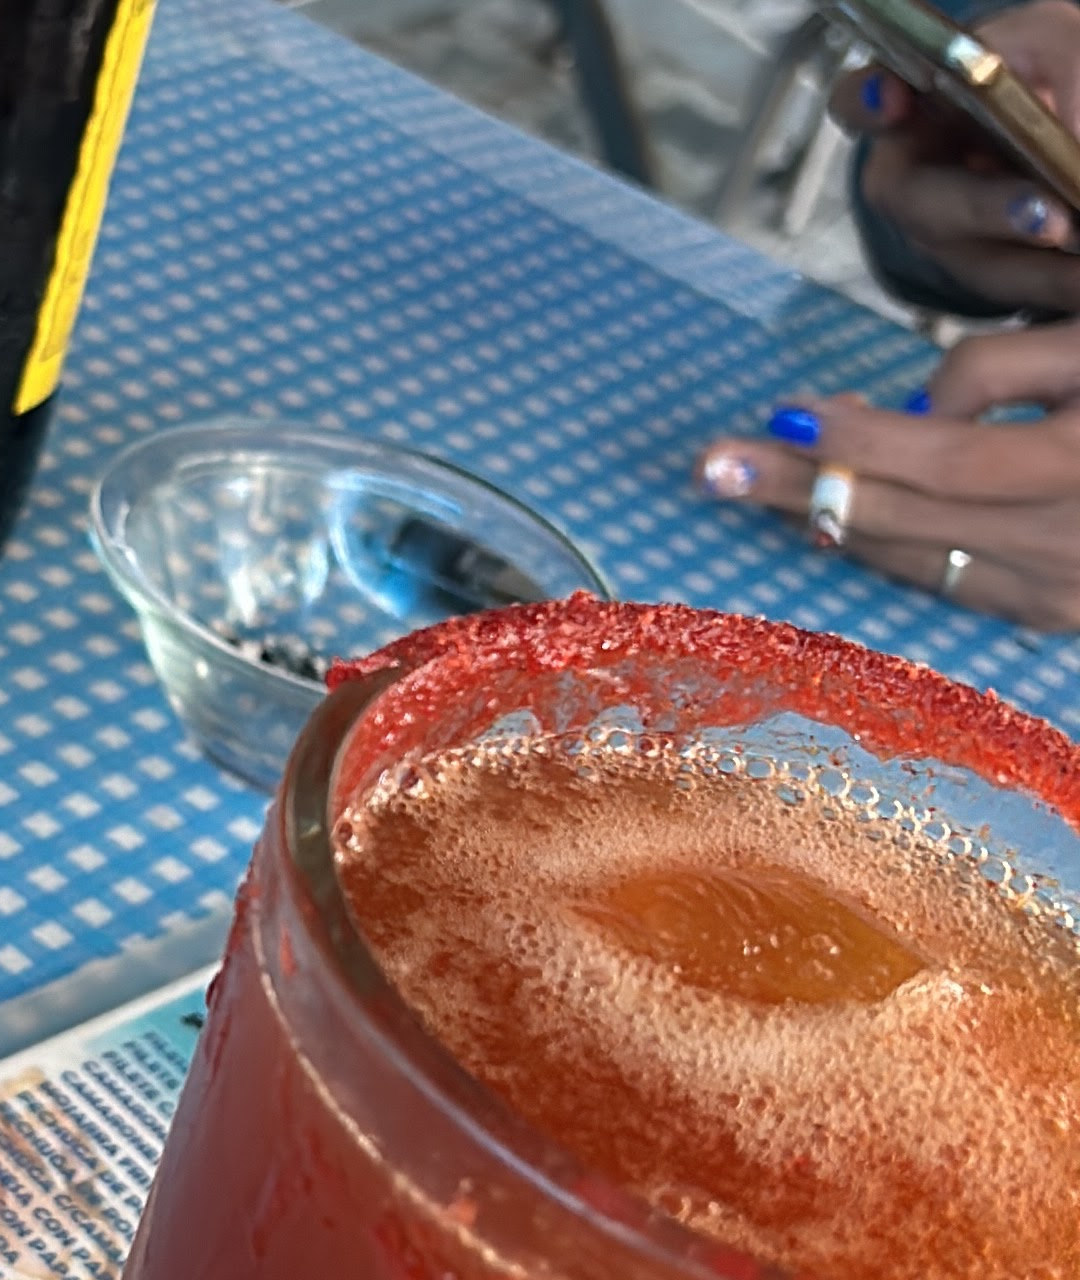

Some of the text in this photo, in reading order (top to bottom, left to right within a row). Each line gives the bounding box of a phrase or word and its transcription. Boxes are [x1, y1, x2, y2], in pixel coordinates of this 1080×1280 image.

[16, 1090, 99, 1170] PECHUGA
[96, 1171, 128, 1195] DE
[38, 1080, 120, 1156] MOJARRA
[31, 1206, 78, 1247] CON
